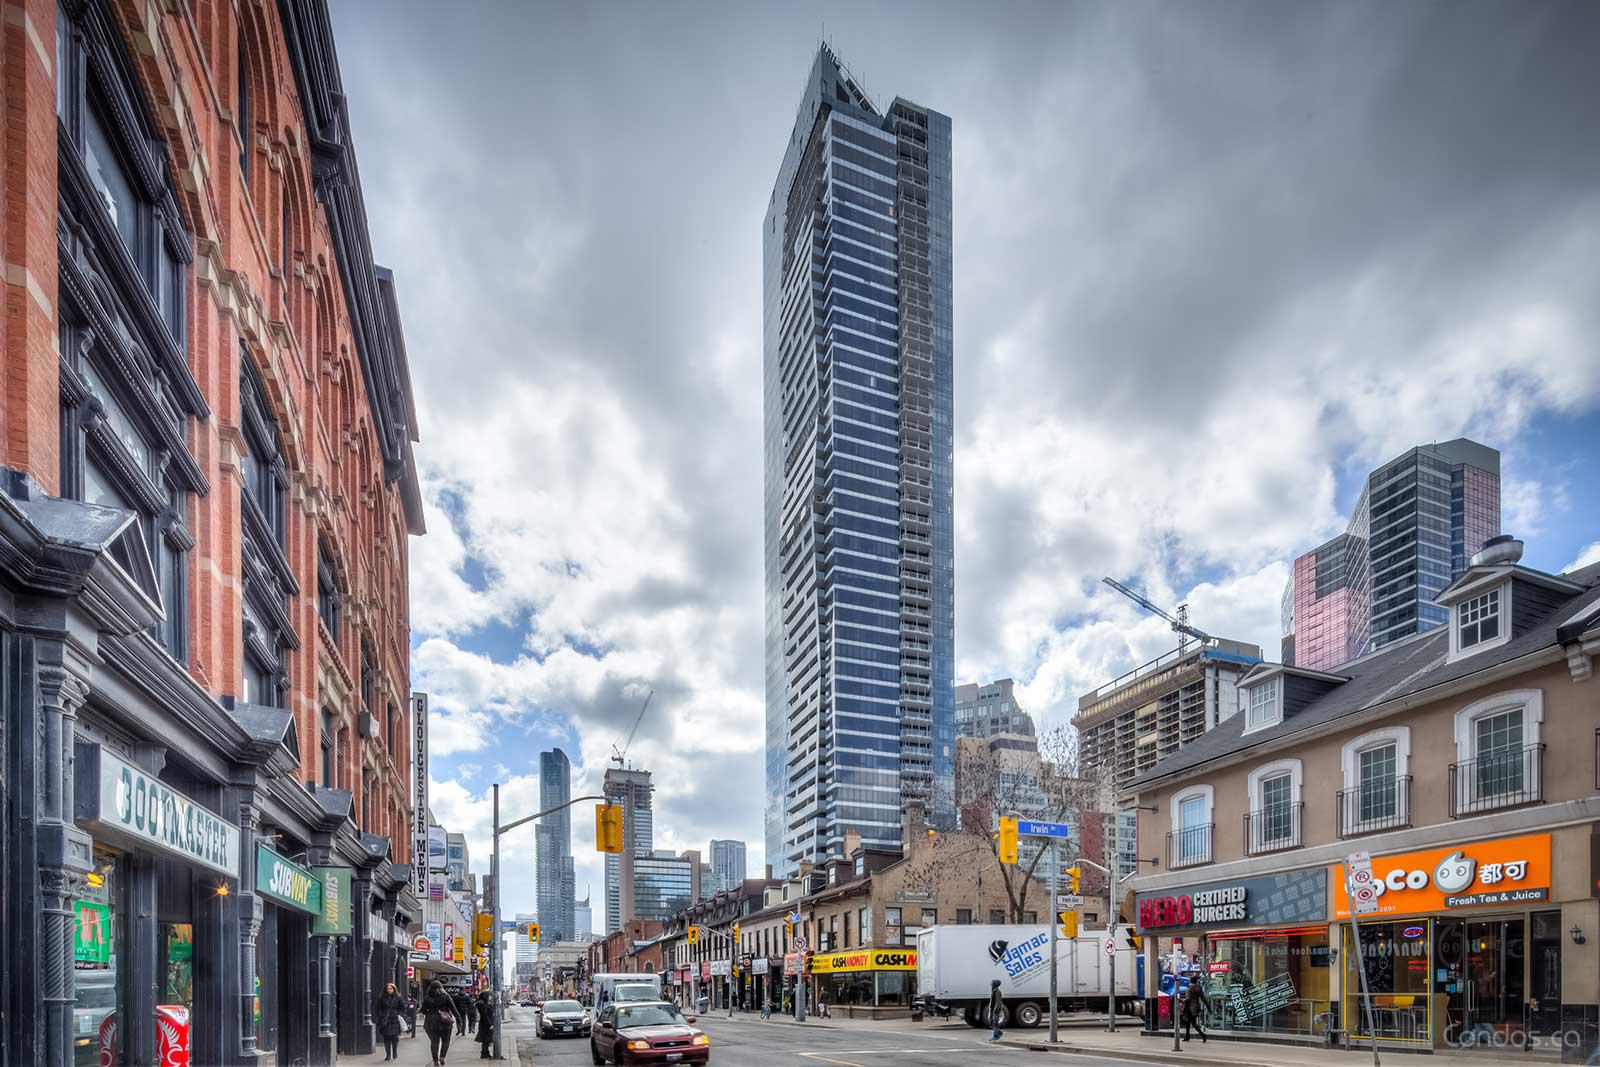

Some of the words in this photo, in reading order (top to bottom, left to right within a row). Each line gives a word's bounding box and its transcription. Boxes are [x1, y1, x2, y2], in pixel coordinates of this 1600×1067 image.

[416, 698, 425, 834] GLOUCESTER
[117, 766, 227, 868] BOOTMASTER
[1030, 823, 1049, 834] Irwin
[269, 860, 312, 905] SUBWAY
[416, 839, 426, 893] MEWS
[1478, 860, 1527, 884] 都可
[325, 871, 339, 930] SUBWAY
[1140, 894, 1192, 929] HERO
[1193, 886, 1246, 907] CERTIFIED
[1193, 902, 1246, 924] BURGERS
[1448, 896, 1476, 907] Fresh
[1479, 894, 1498, 903] Tea
[1500, 892, 1509, 901] &
[1512, 890, 1542, 901] Juice
[1231, 992, 1249, 1023] RAISED
